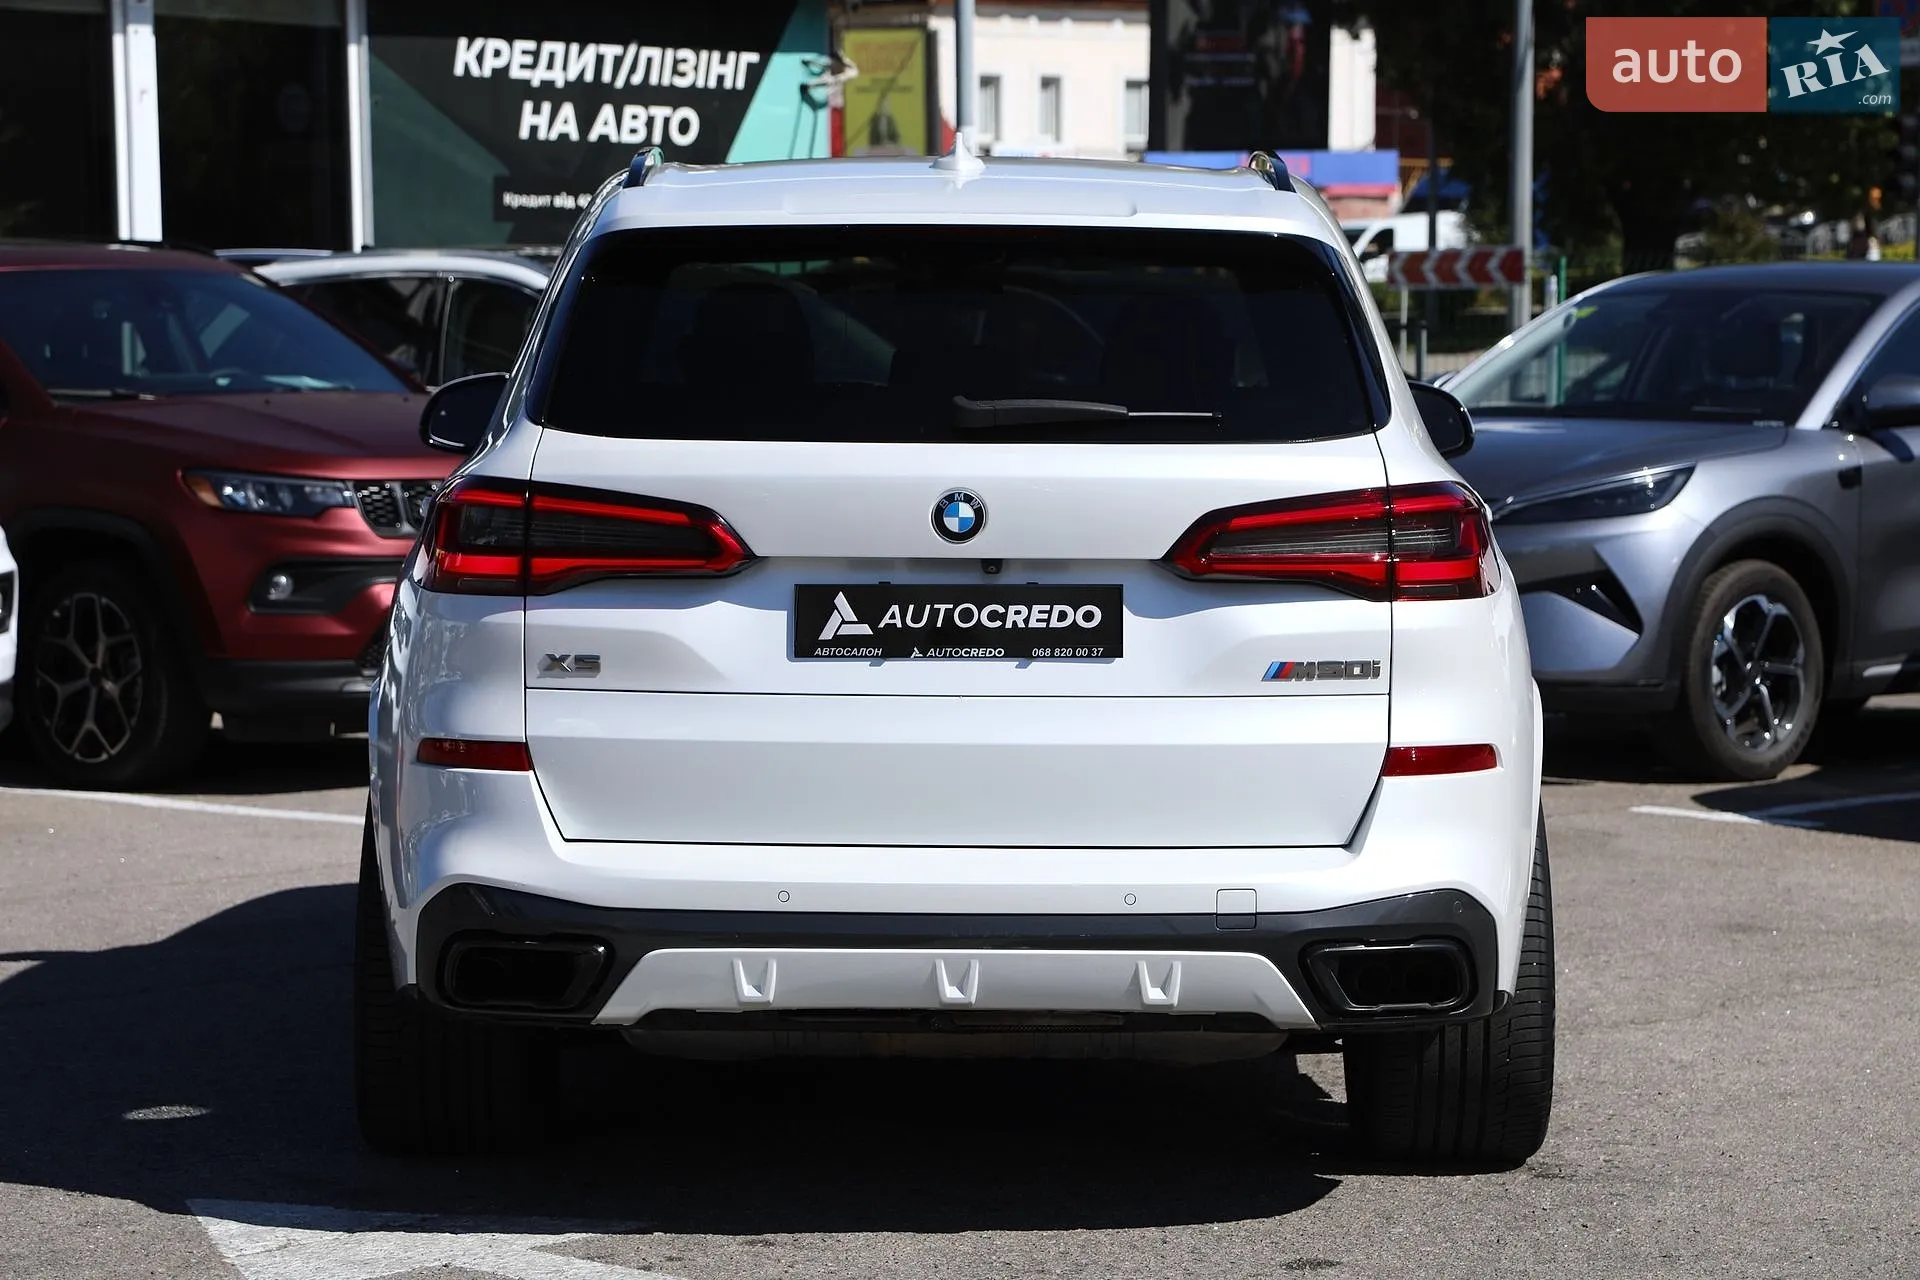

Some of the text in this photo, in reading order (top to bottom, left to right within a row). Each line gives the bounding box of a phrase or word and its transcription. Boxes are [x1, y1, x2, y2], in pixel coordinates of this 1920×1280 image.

[453, 36, 760, 90] КРЕДИТ/ЛІЗІНГ
[518, 100, 700, 146] НА АВТО
[503, 191, 552, 209] Кредит
[878, 603, 1102, 629] AUTOCREDO
[814, 647, 882, 657] АВТОСАЛОН
[926, 647, 1005, 657] AUTOCREDO
[1032, 647, 1103, 657] 068 820 00 37
[540, 653, 602, 677] X5
